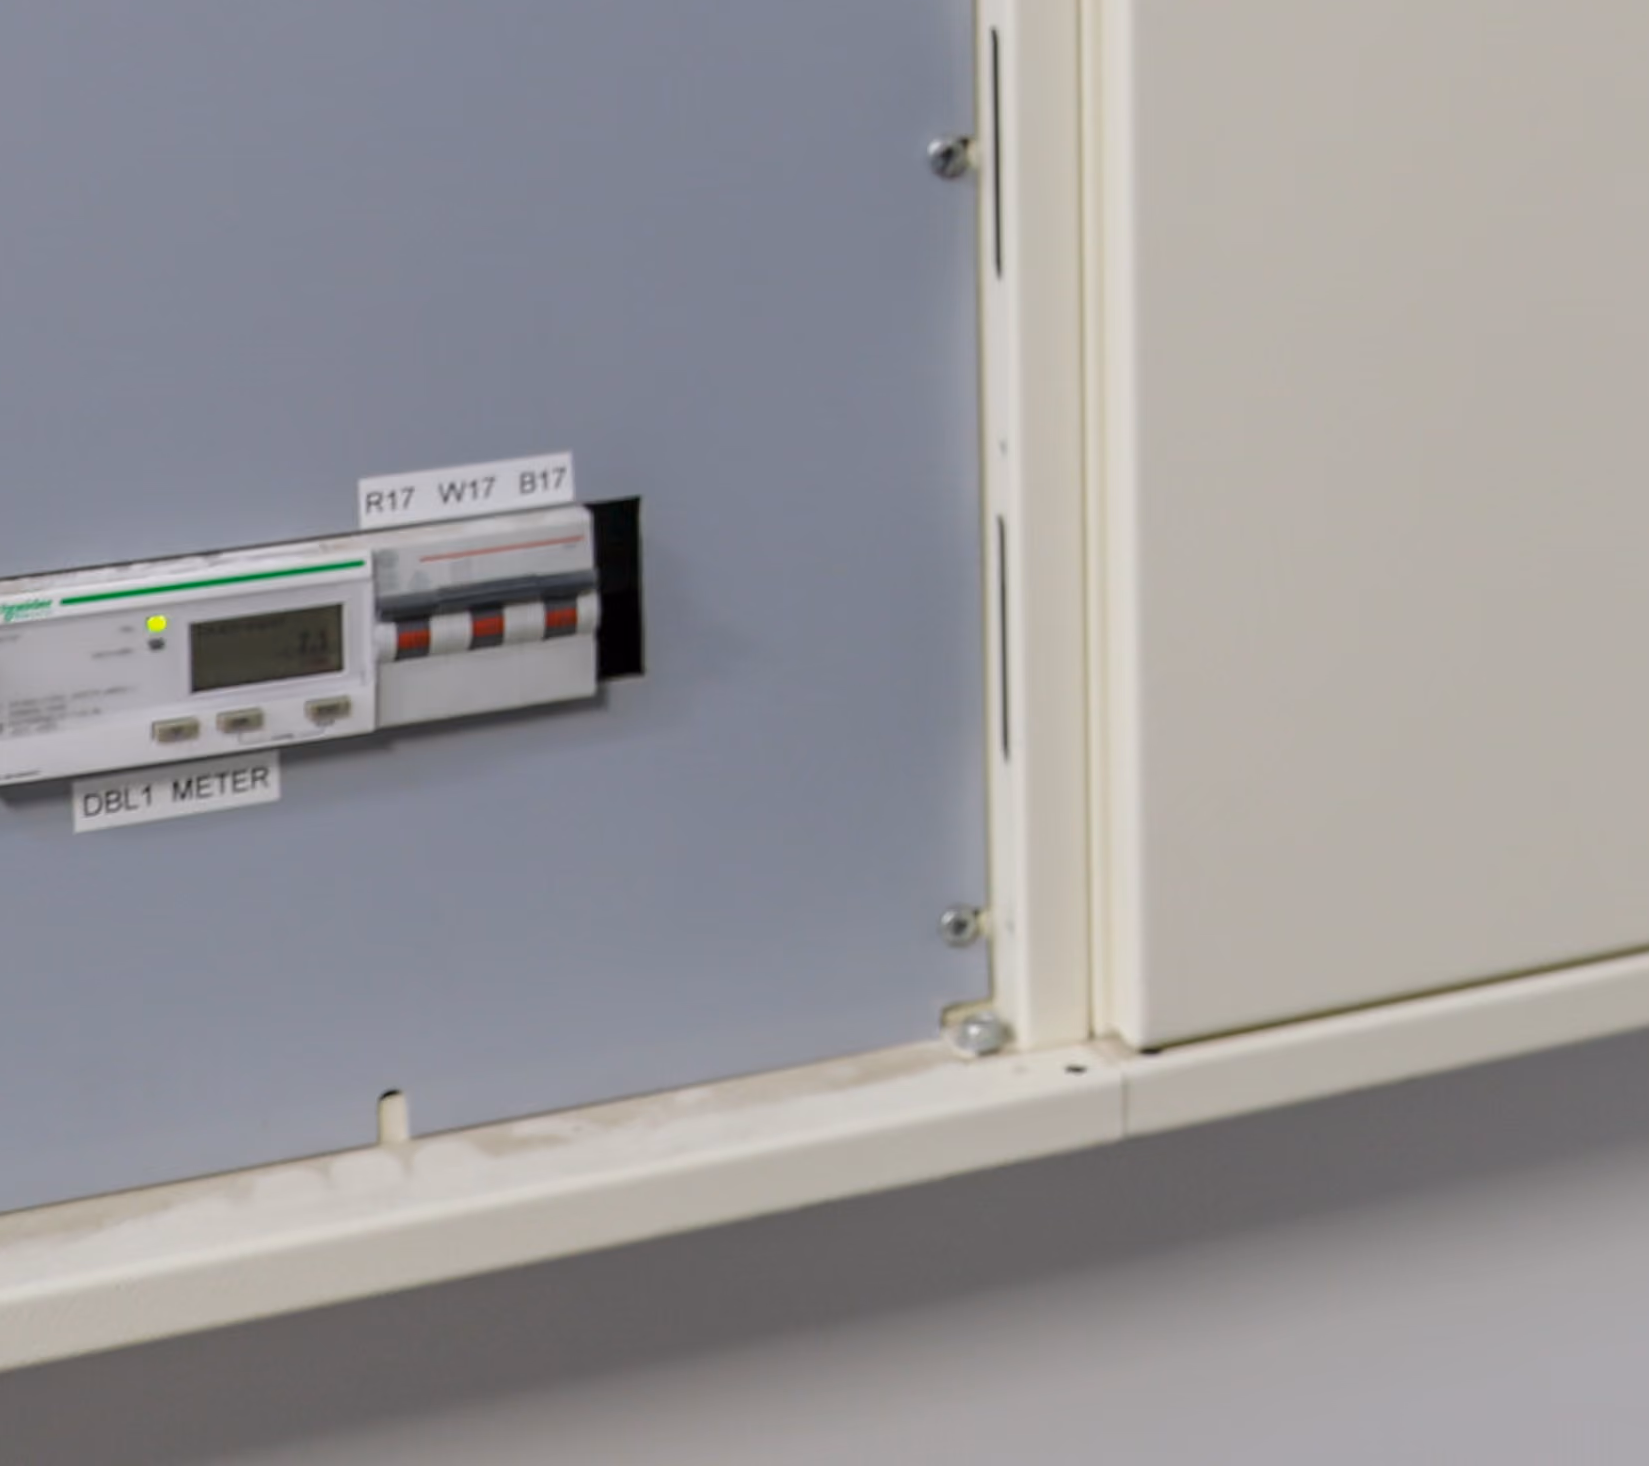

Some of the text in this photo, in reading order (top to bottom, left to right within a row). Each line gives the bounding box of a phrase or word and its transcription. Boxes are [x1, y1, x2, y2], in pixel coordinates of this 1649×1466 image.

[365, 466, 567, 514] R17 W17 B17
[84, 768, 270, 818] DBL1 METER
